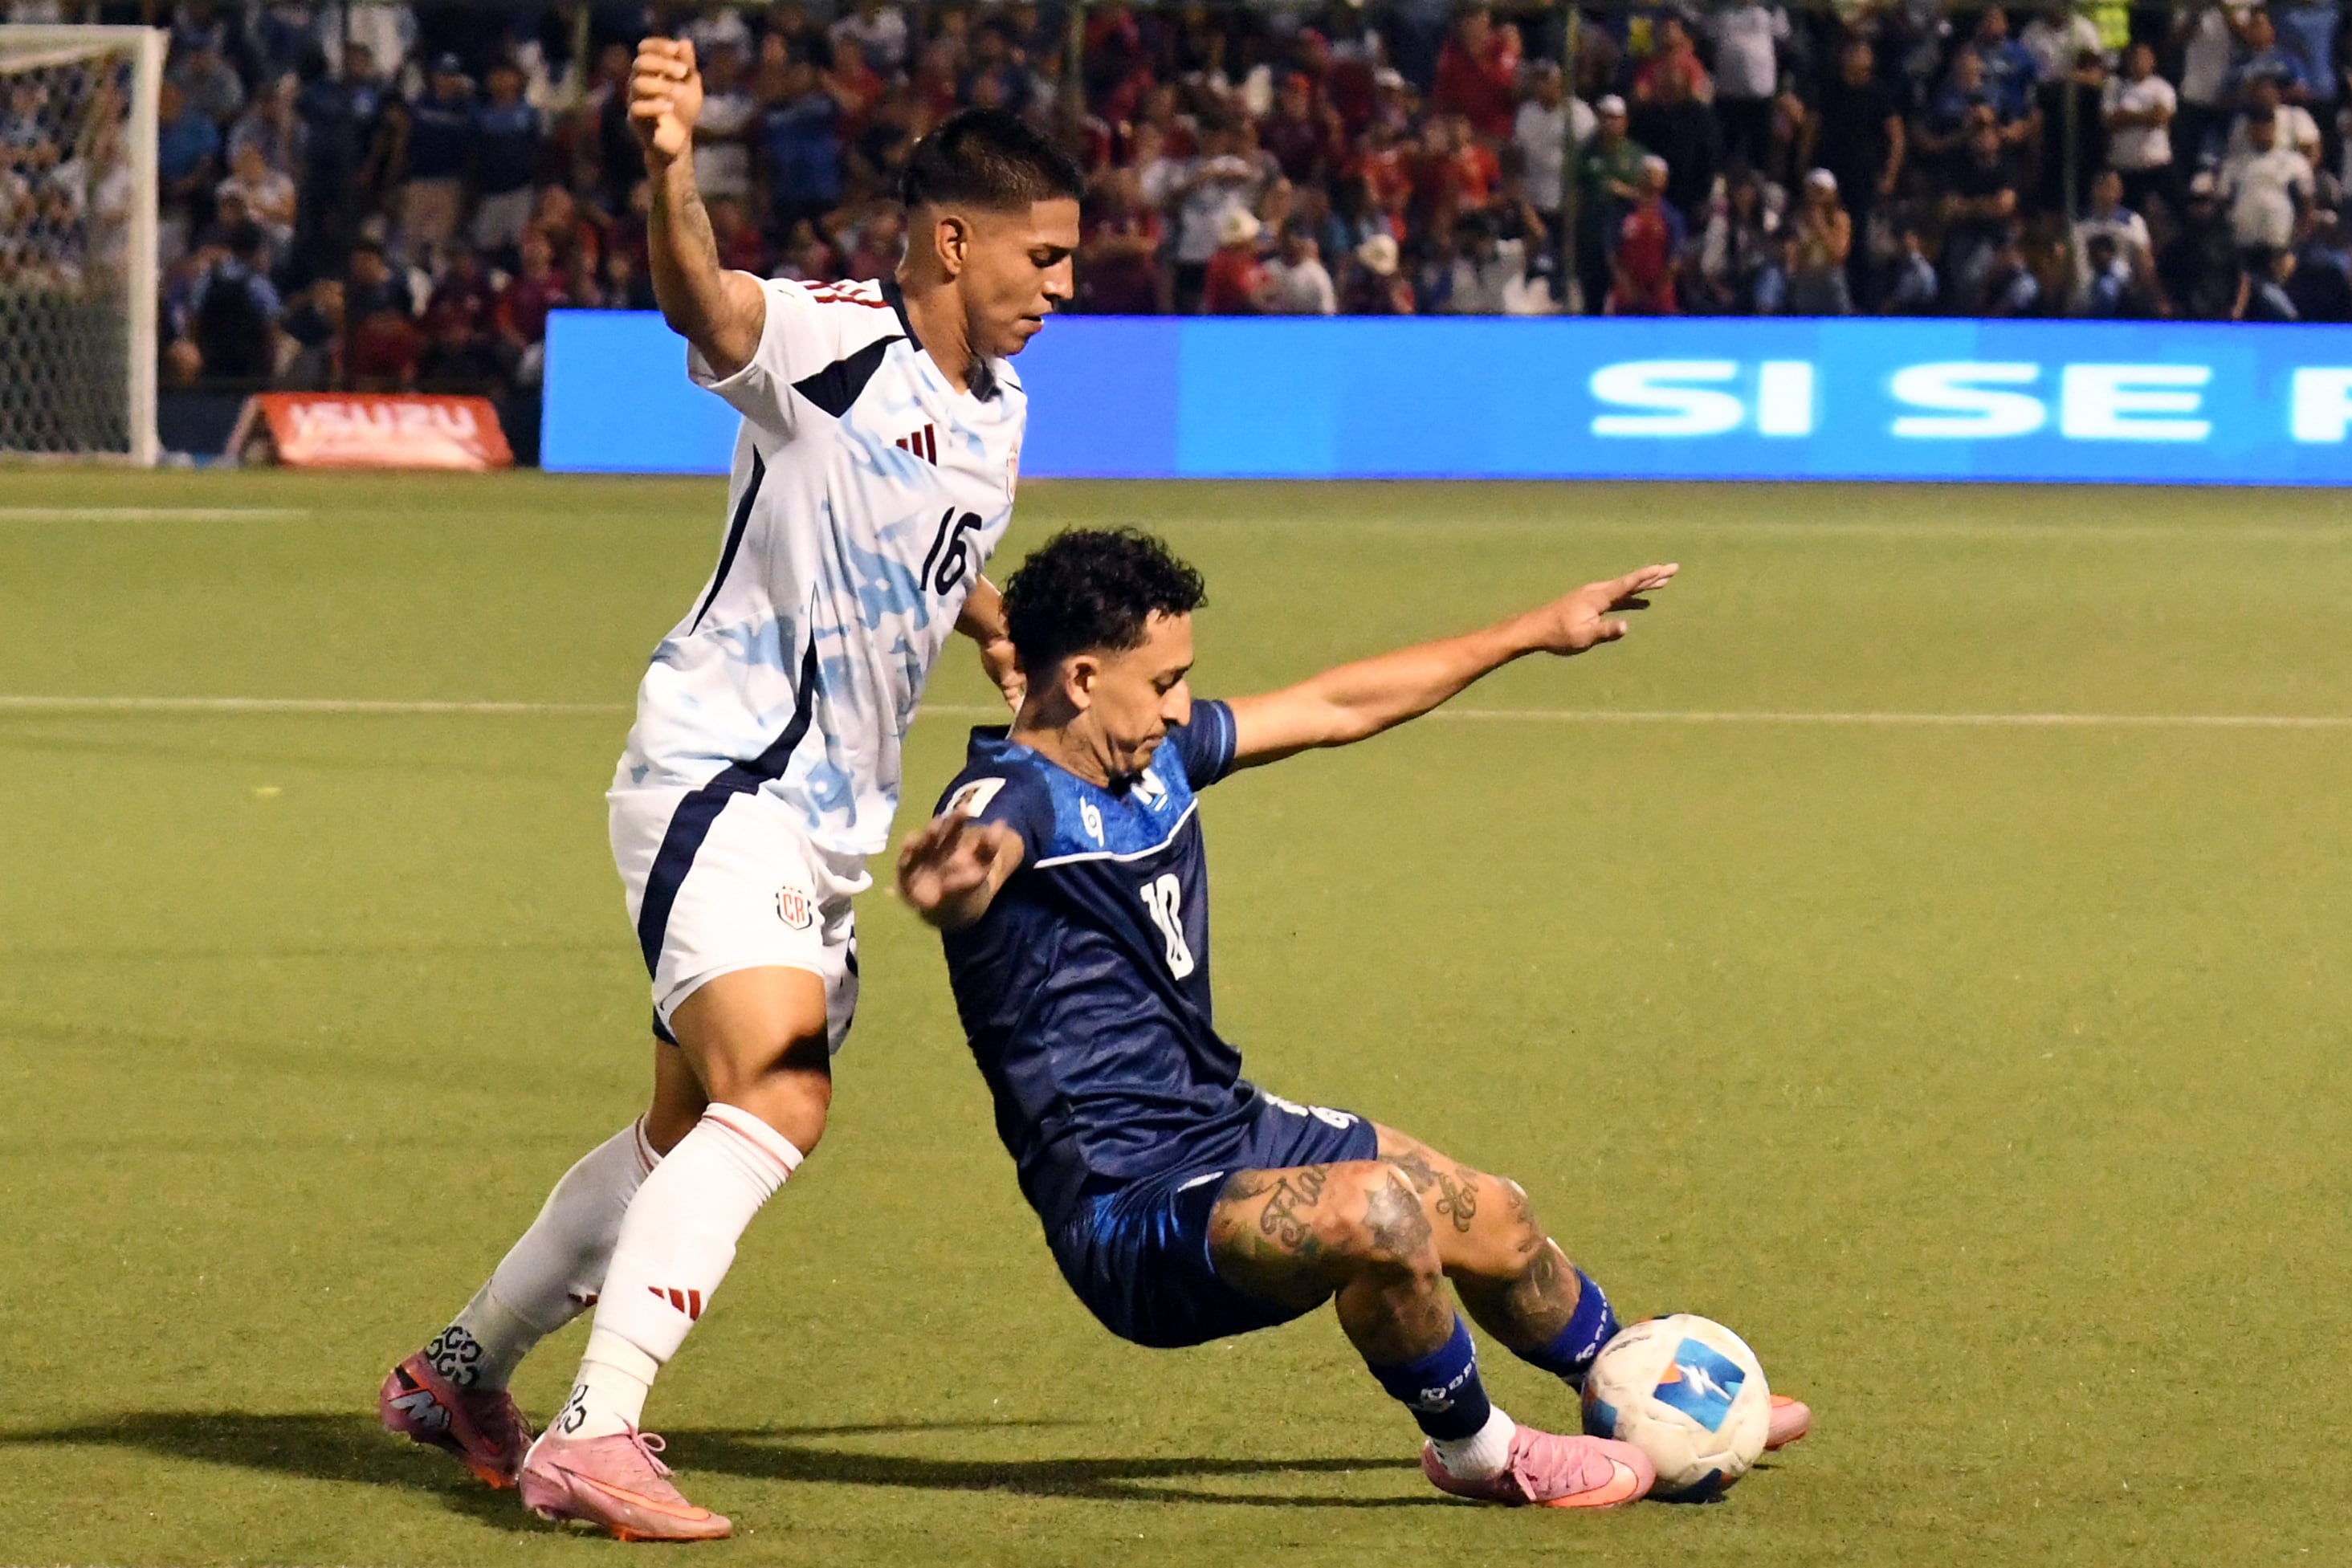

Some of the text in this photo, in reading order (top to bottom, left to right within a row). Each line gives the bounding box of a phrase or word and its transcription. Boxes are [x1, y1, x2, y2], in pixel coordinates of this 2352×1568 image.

[1588, 360, 1813, 438] SI
[1890, 362, 2213, 441] SE
[919, 506, 982, 596] 16
[783, 894, 805, 923] CR
[1139, 872, 1195, 980] 10
